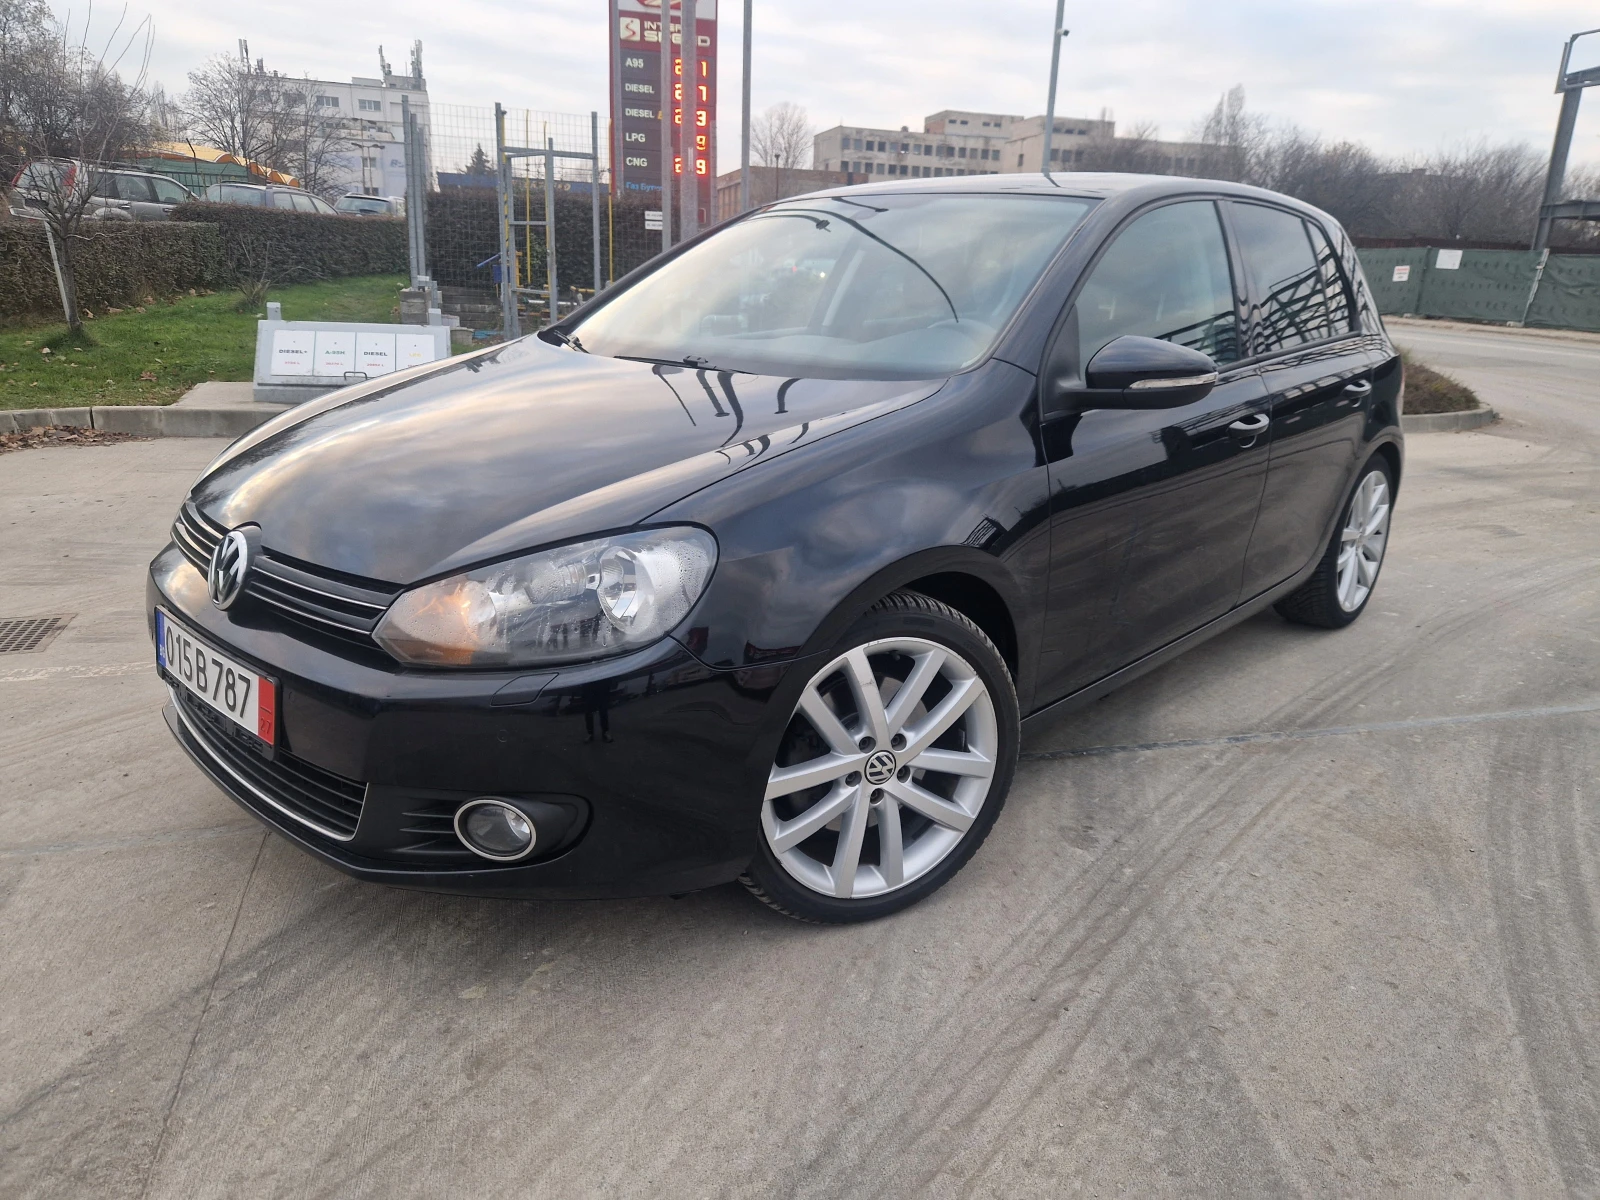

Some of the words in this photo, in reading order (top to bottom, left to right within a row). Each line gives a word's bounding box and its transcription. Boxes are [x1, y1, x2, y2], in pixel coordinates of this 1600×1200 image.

[626, 57, 644, 68] A95
[625, 83, 655, 94] DIESEL
[625, 108, 655, 118] DIESEL
[626, 132, 646, 142] LPG
[626, 156, 648, 167] CNG
[260, 717, 272, 735] 27
